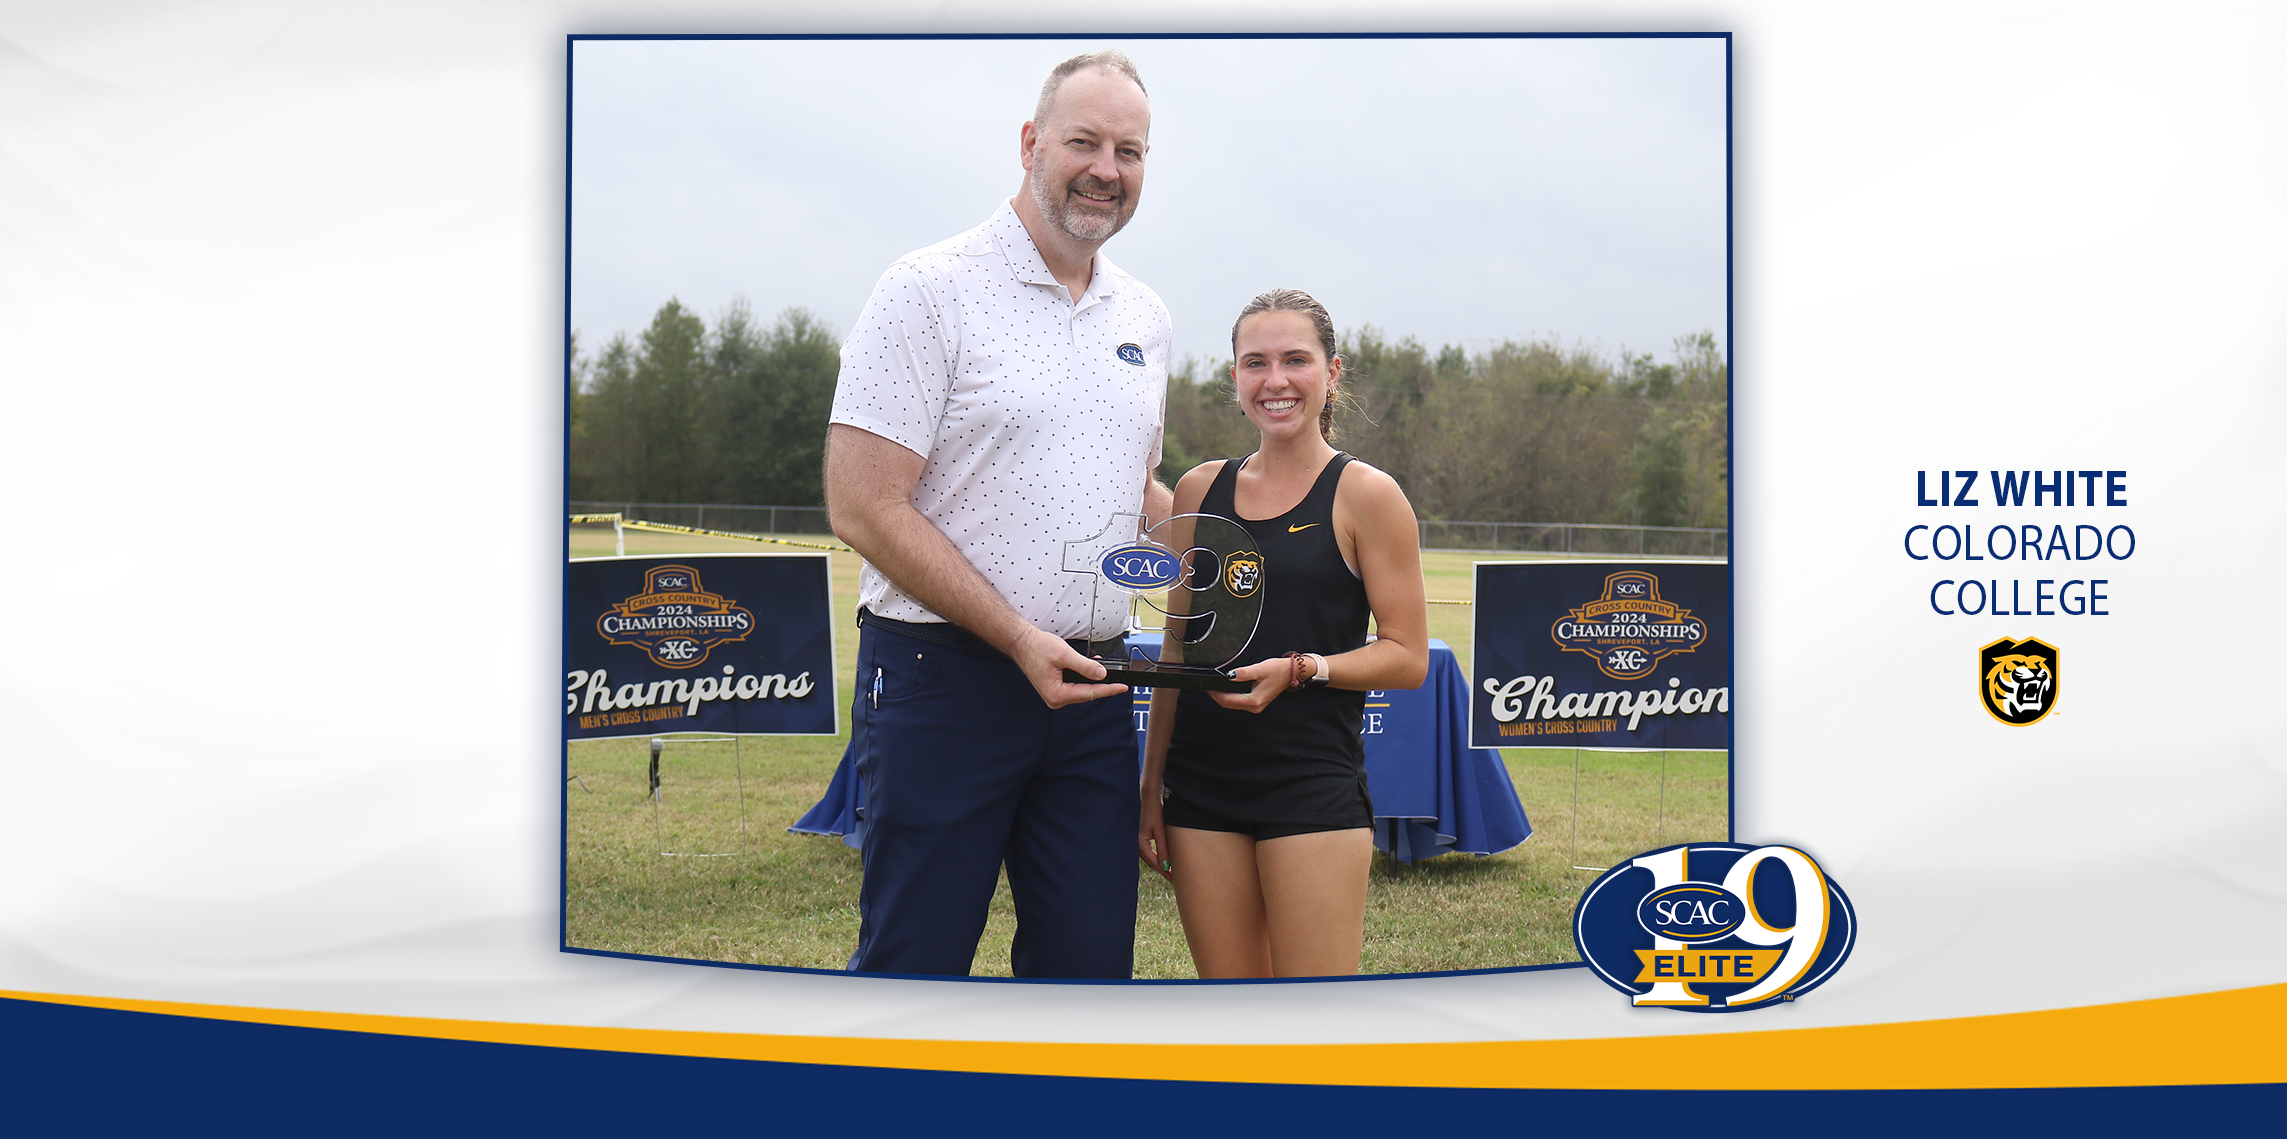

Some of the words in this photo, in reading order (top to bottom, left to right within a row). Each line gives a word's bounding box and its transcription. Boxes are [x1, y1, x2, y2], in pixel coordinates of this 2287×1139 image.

[1112, 556, 1170, 579] SCAC
[658, 577, 687, 588] SCAC
[1616, 583, 1646, 594] SCAC
[632, 595, 665, 609] CROSS
[667, 594, 716, 606] COUNTRY
[1588, 601, 1622, 615] CROSS
[1624, 601, 1672, 615] COUNTRY
[657, 605, 693, 616] 2024
[603, 612, 749, 634] CHAMPIONSHIPS
[1611, 613, 1647, 623] 2024
[645, 629, 697, 637] SHREVEPORT,
[1557, 622, 1701, 640] CHAMPIONSHIPS
[579, 714, 610, 730] MEN'S
[611, 710, 641, 726] CROSS
[642, 705, 684, 722] COUNTRY
[1498, 722, 1544, 737] WOMEN'S
[1545, 720, 1575, 734] CROSS
[1576, 719, 1618, 733] COUNTRY
